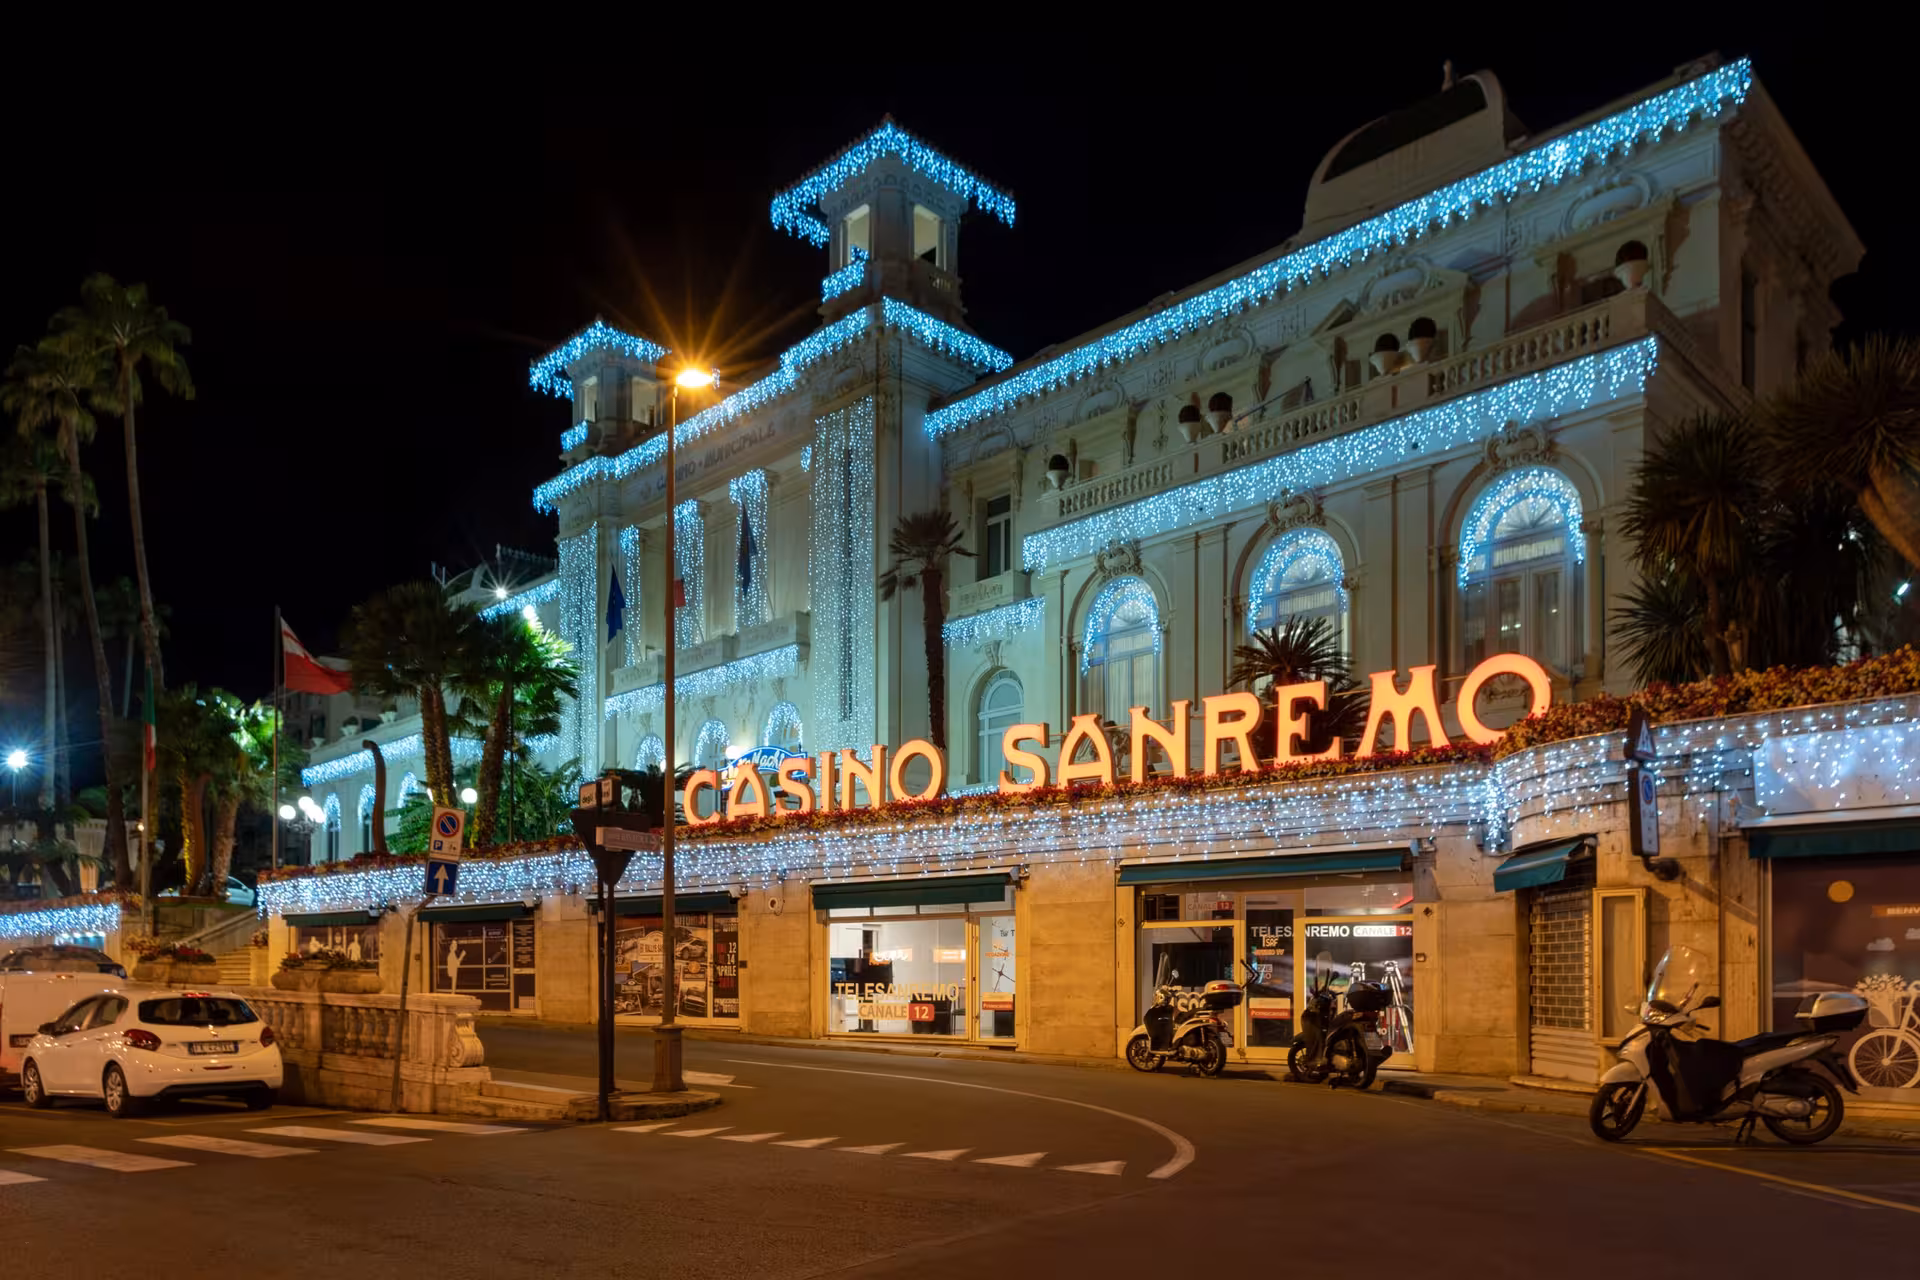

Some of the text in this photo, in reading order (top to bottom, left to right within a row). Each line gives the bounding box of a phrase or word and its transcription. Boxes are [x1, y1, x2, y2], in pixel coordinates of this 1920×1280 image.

[703, 421, 775, 468] MUNICIPALE
[684, 652, 1552, 825] CASINO SANREMO
[1251, 925, 1412, 938] TELESNREMO CANALE 12
[728, 942, 736, 953] 12
[727, 953, 735, 964] 14
[835, 983, 959, 1001] TELESANREMO
[858, 1004, 929, 1018] CANALE 12
